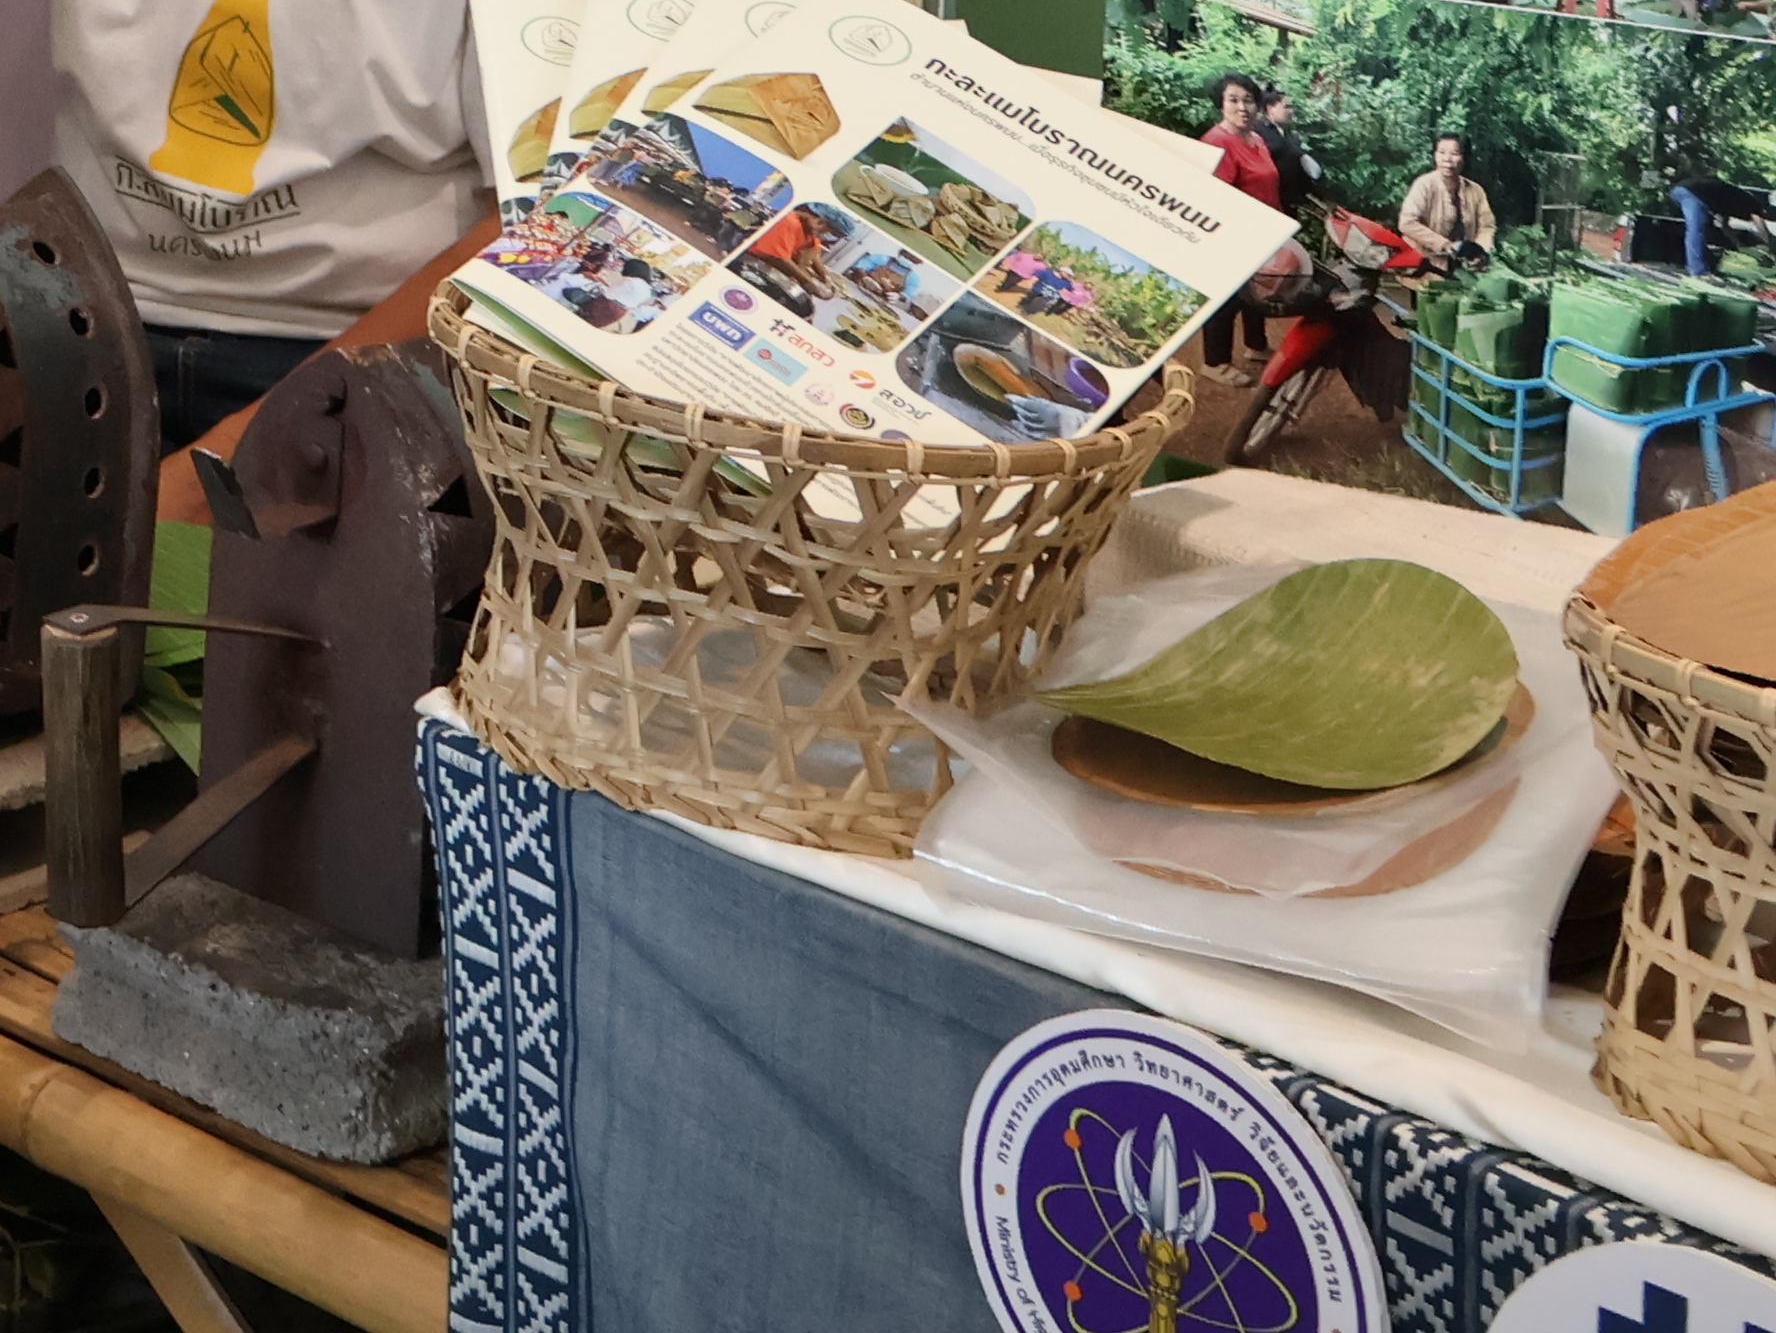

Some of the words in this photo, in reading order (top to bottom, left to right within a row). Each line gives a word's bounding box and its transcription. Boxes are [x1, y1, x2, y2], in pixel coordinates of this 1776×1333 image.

[924, 57, 1221, 234] กะละแมโบราณนครพนม
[789, 334, 835, 368] สกสว
[996, 1048, 1127, 1165] กระทรวงการอุดมศึกษา
[1133, 1050, 1246, 1123] วิทยาศาสตร์
[1247, 1120, 1343, 1305] วิจัยและนวัตกรรม
[995, 1215, 1021, 1283] Ministry
